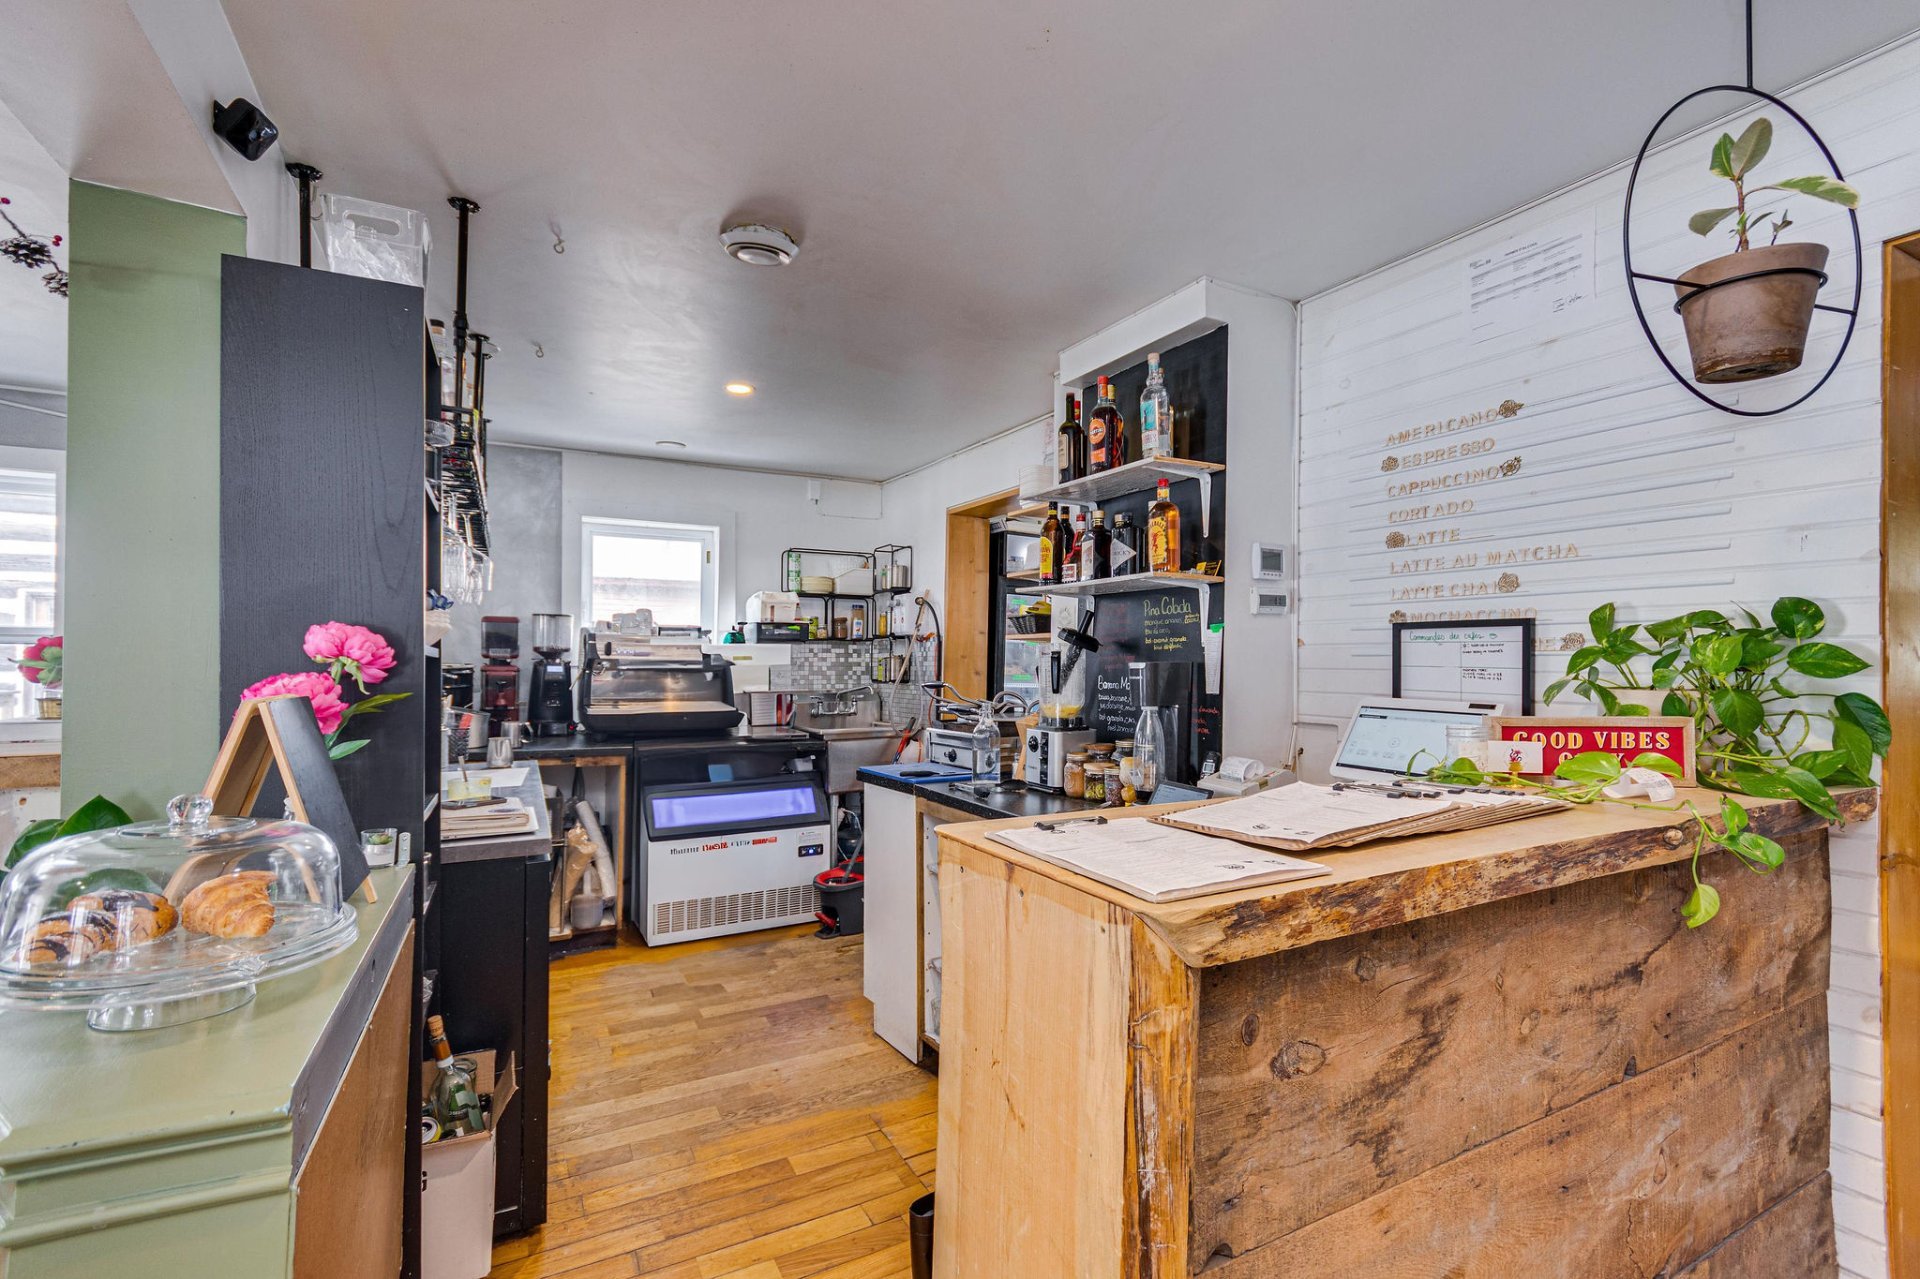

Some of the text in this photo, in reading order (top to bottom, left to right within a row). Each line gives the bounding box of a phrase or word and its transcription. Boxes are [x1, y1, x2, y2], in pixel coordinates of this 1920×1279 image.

[1385, 408, 1499, 447] AMERICANO
[1402, 438, 1496, 469] ESPRESSO
[1388, 466, 1500, 497] CAPPUCCINO
[1388, 499, 1475, 524] CORTADO
[1406, 527, 1461, 547] LATTE
[1390, 542, 1581, 574] LATTE AU MATCHA
[1391, 580, 1500, 601] LATTE CHAI
[1410, 607, 1538, 622] MOCHACCINO
[1513, 731, 1670, 749] GOOD VIBES
